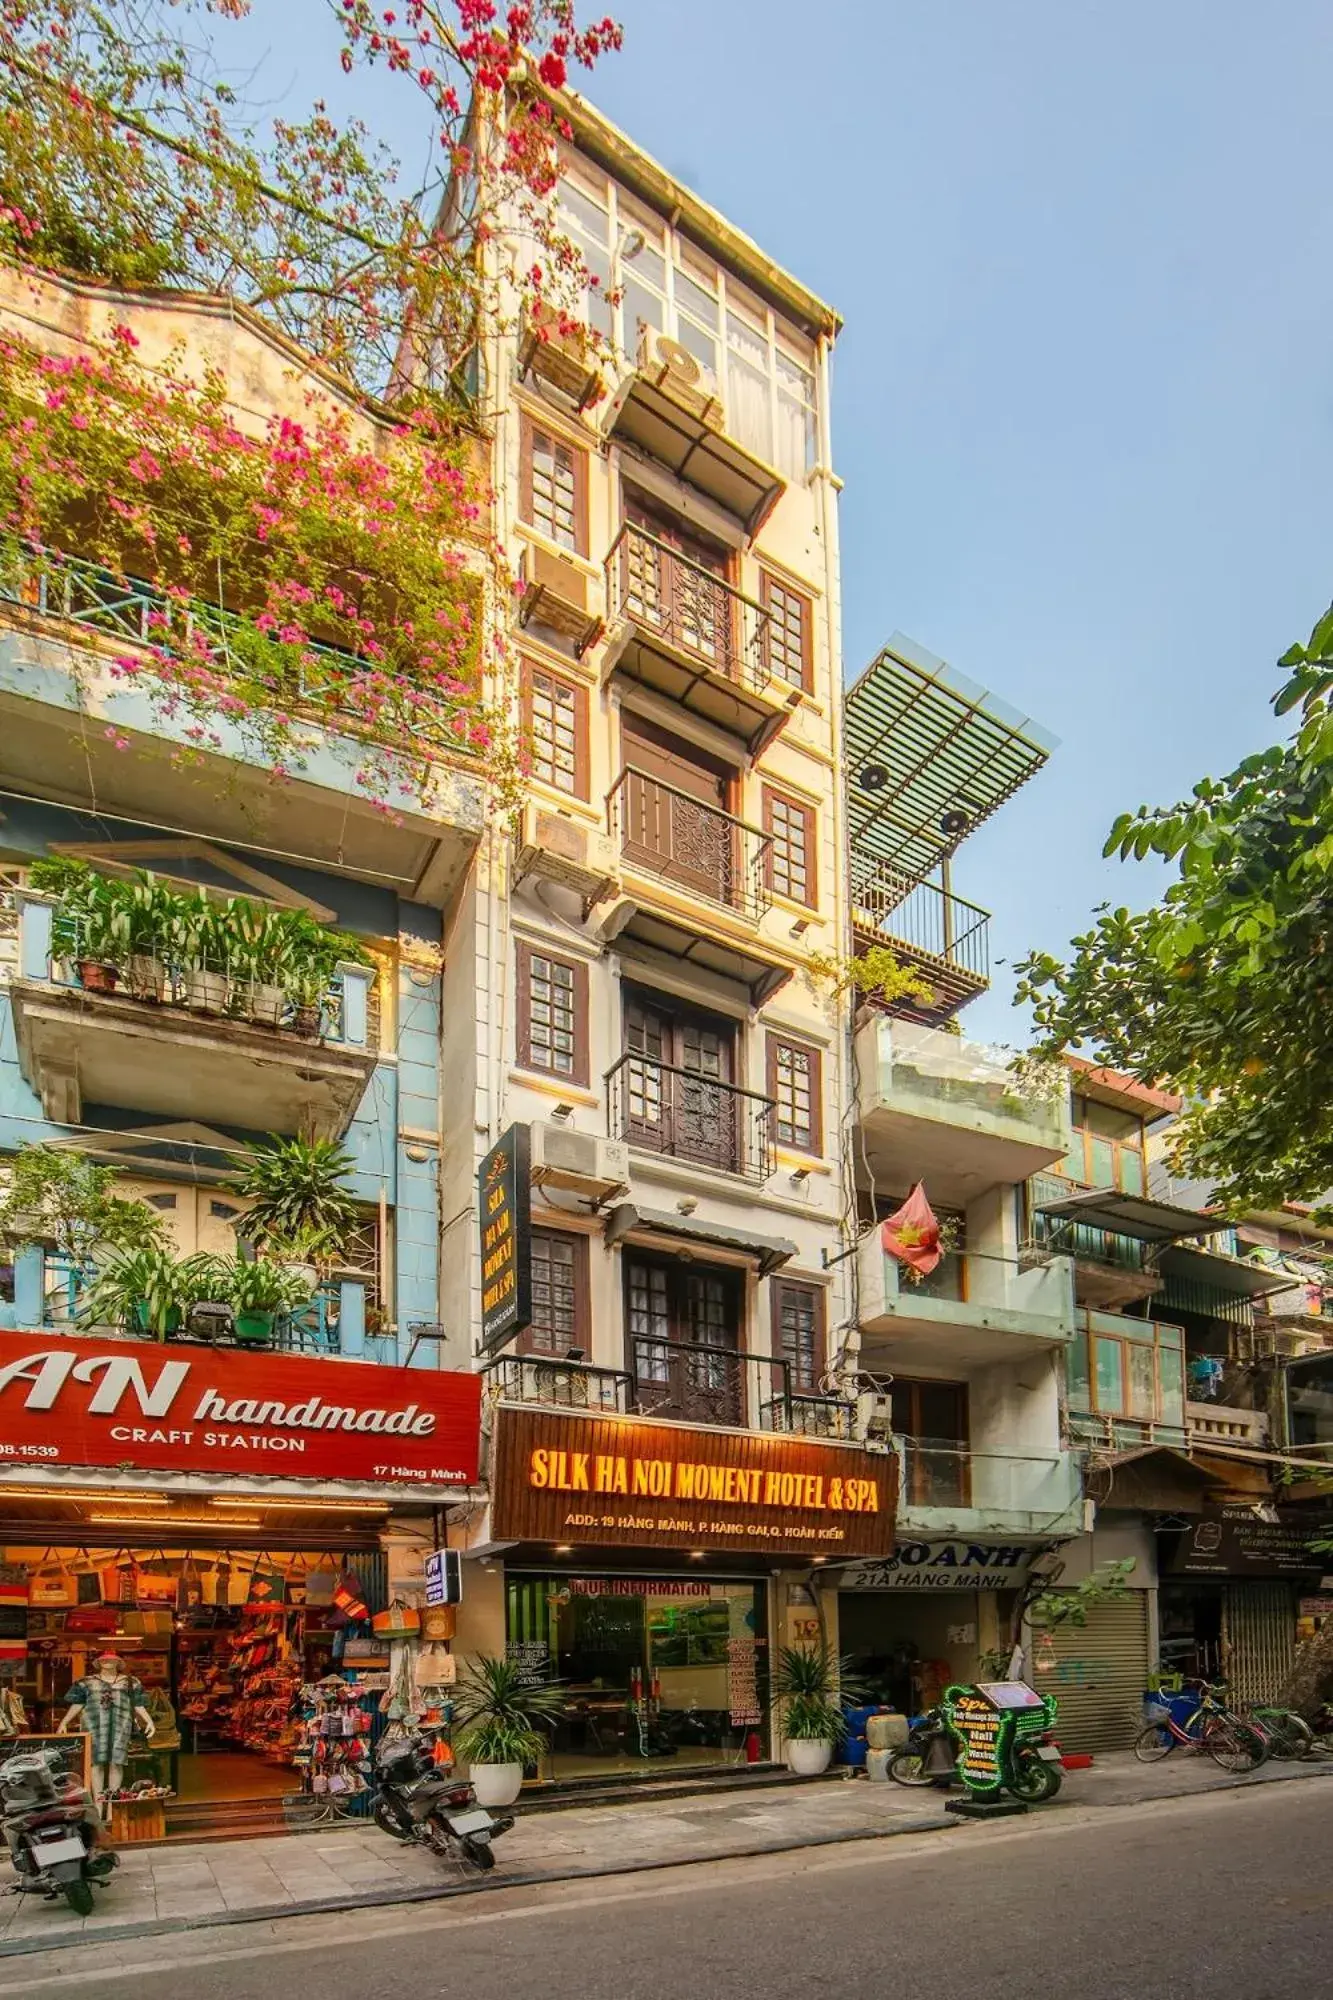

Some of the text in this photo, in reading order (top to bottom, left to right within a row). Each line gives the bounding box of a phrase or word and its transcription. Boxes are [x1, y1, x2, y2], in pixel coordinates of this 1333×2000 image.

[194, 1388, 437, 1437] handmade
[110, 1426, 305, 1453] CRAFT STATION
[373, 1466, 388, 1476] 17
[391, 1466, 427, 1480] Hàng
[530, 1449, 589, 1491] SILK
[595, 1455, 628, 1493] HA
[632, 1459, 672, 1496] NOI
[676, 1463, 762, 1503] MOMENT
[767, 1471, 826, 1510] HOTEL
[565, 1513, 598, 1526] ADD:
[600, 1515, 614, 1527] 19
[618, 1514, 654, 1529] HÀNG
[699, 1521, 709, 1532] P.
[711, 1520, 744, 1534] HÀNG
[612, 1580, 711, 1597] INFORMATION
[895, 1570, 950, 1586] HÀNG
